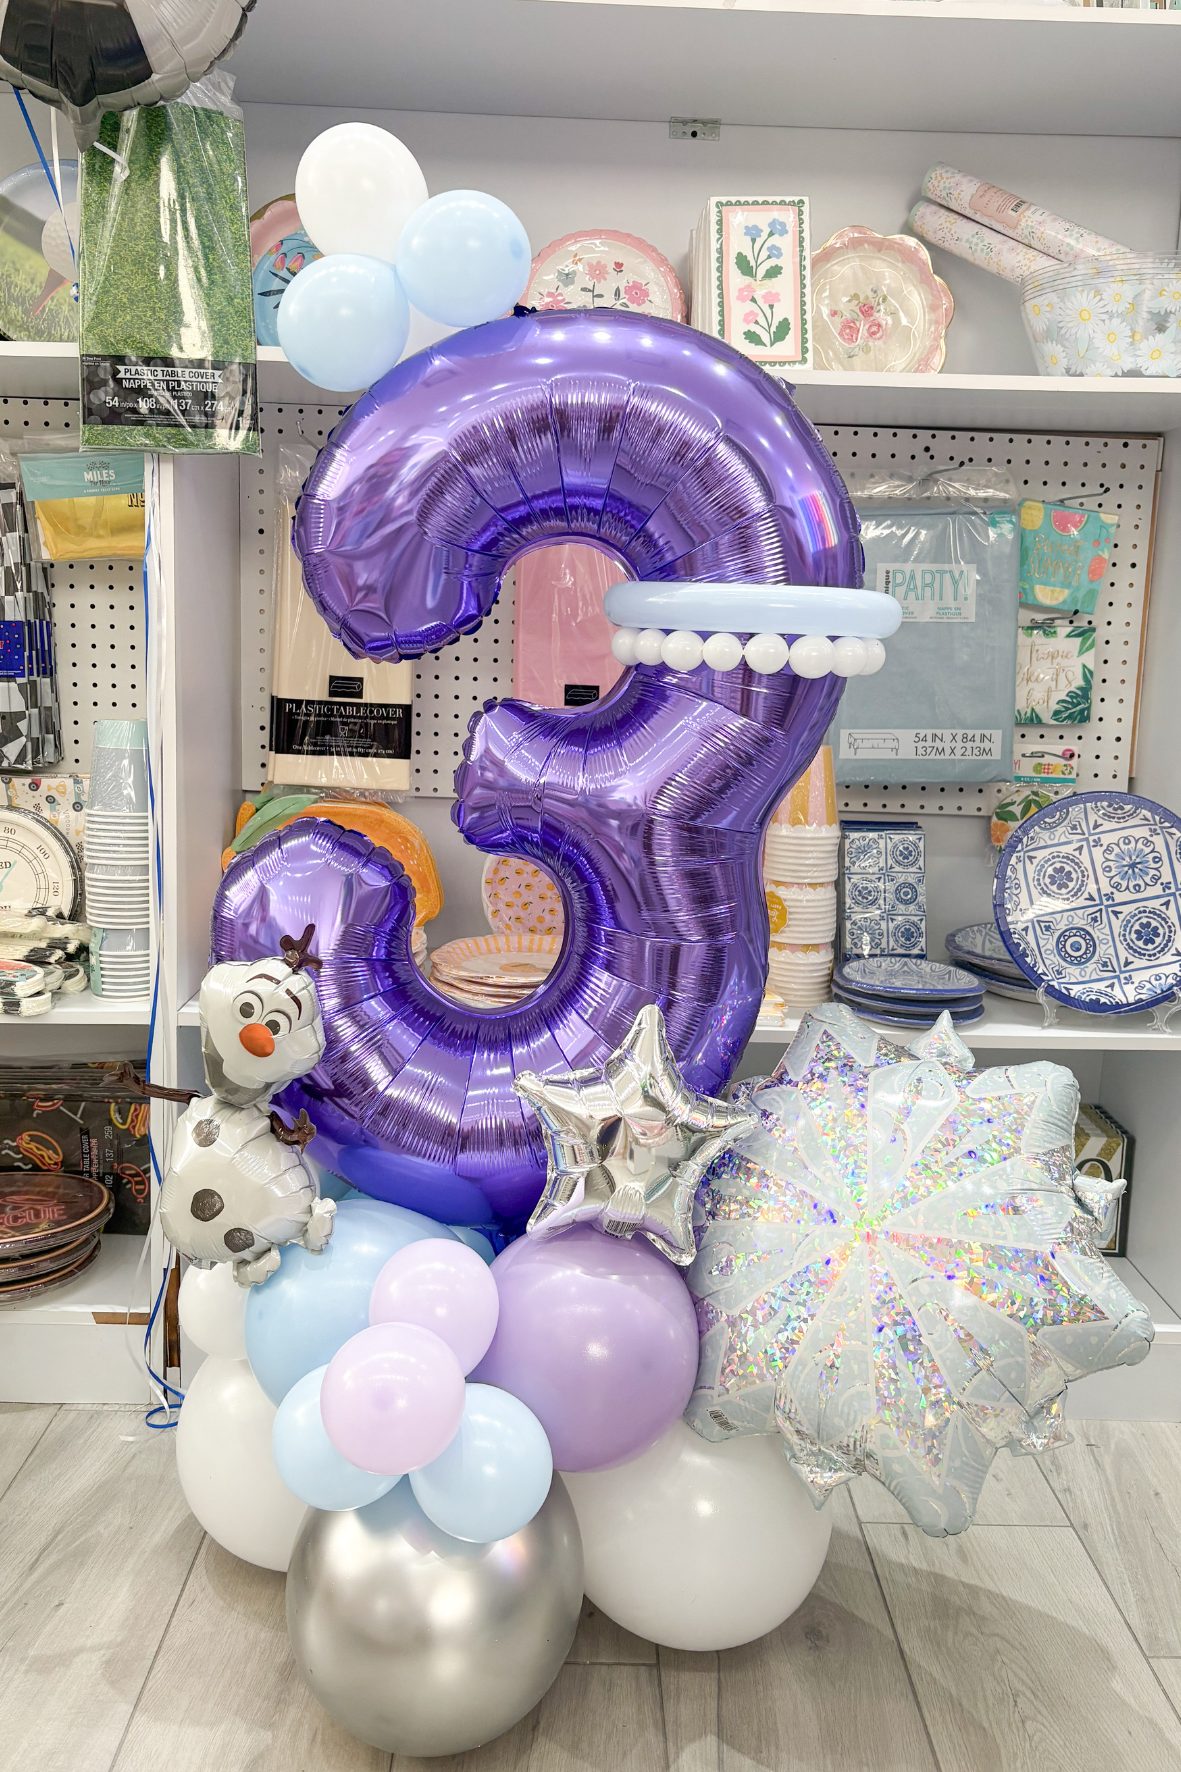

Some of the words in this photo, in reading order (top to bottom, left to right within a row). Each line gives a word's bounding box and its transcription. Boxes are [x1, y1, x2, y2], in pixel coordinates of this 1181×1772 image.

[124, 368, 159, 378] PLASTIC
[161, 369, 186, 379] TABLE
[188, 370, 216, 380] COVER
[122, 379, 153, 389] NAPPE
[154, 380, 167, 391] EN
[169, 381, 218, 393] PLASTIQUE
[105, 396, 119, 408] 54
[137, 397, 156, 409] 108
[204, 400, 224, 412] 274
[84, 470, 116, 482] MILES
[1027, 552, 1084, 586] SUMMER
[891, 569, 969, 602] PARTY!
[913, 732, 928, 744] 54
[931, 732, 946, 744] IN.
[949, 733, 958, 744] X
[961, 733, 976, 744] 84
[979, 733, 995, 744] IN.
[914, 746, 946, 757] 1.37M
[949, 746, 957, 757] X
[960, 746, 993, 757] 2.13M
[3, 826, 17, 836] 80
[36, 844, 51, 860] 100
[52, 881, 60, 897] 120
[104, 1125, 113, 1139] 259
[81, 1134, 89, 1153] COVER
[105, 1148, 114, 1162] 137
[82, 1154, 90, 1172] TABLE
